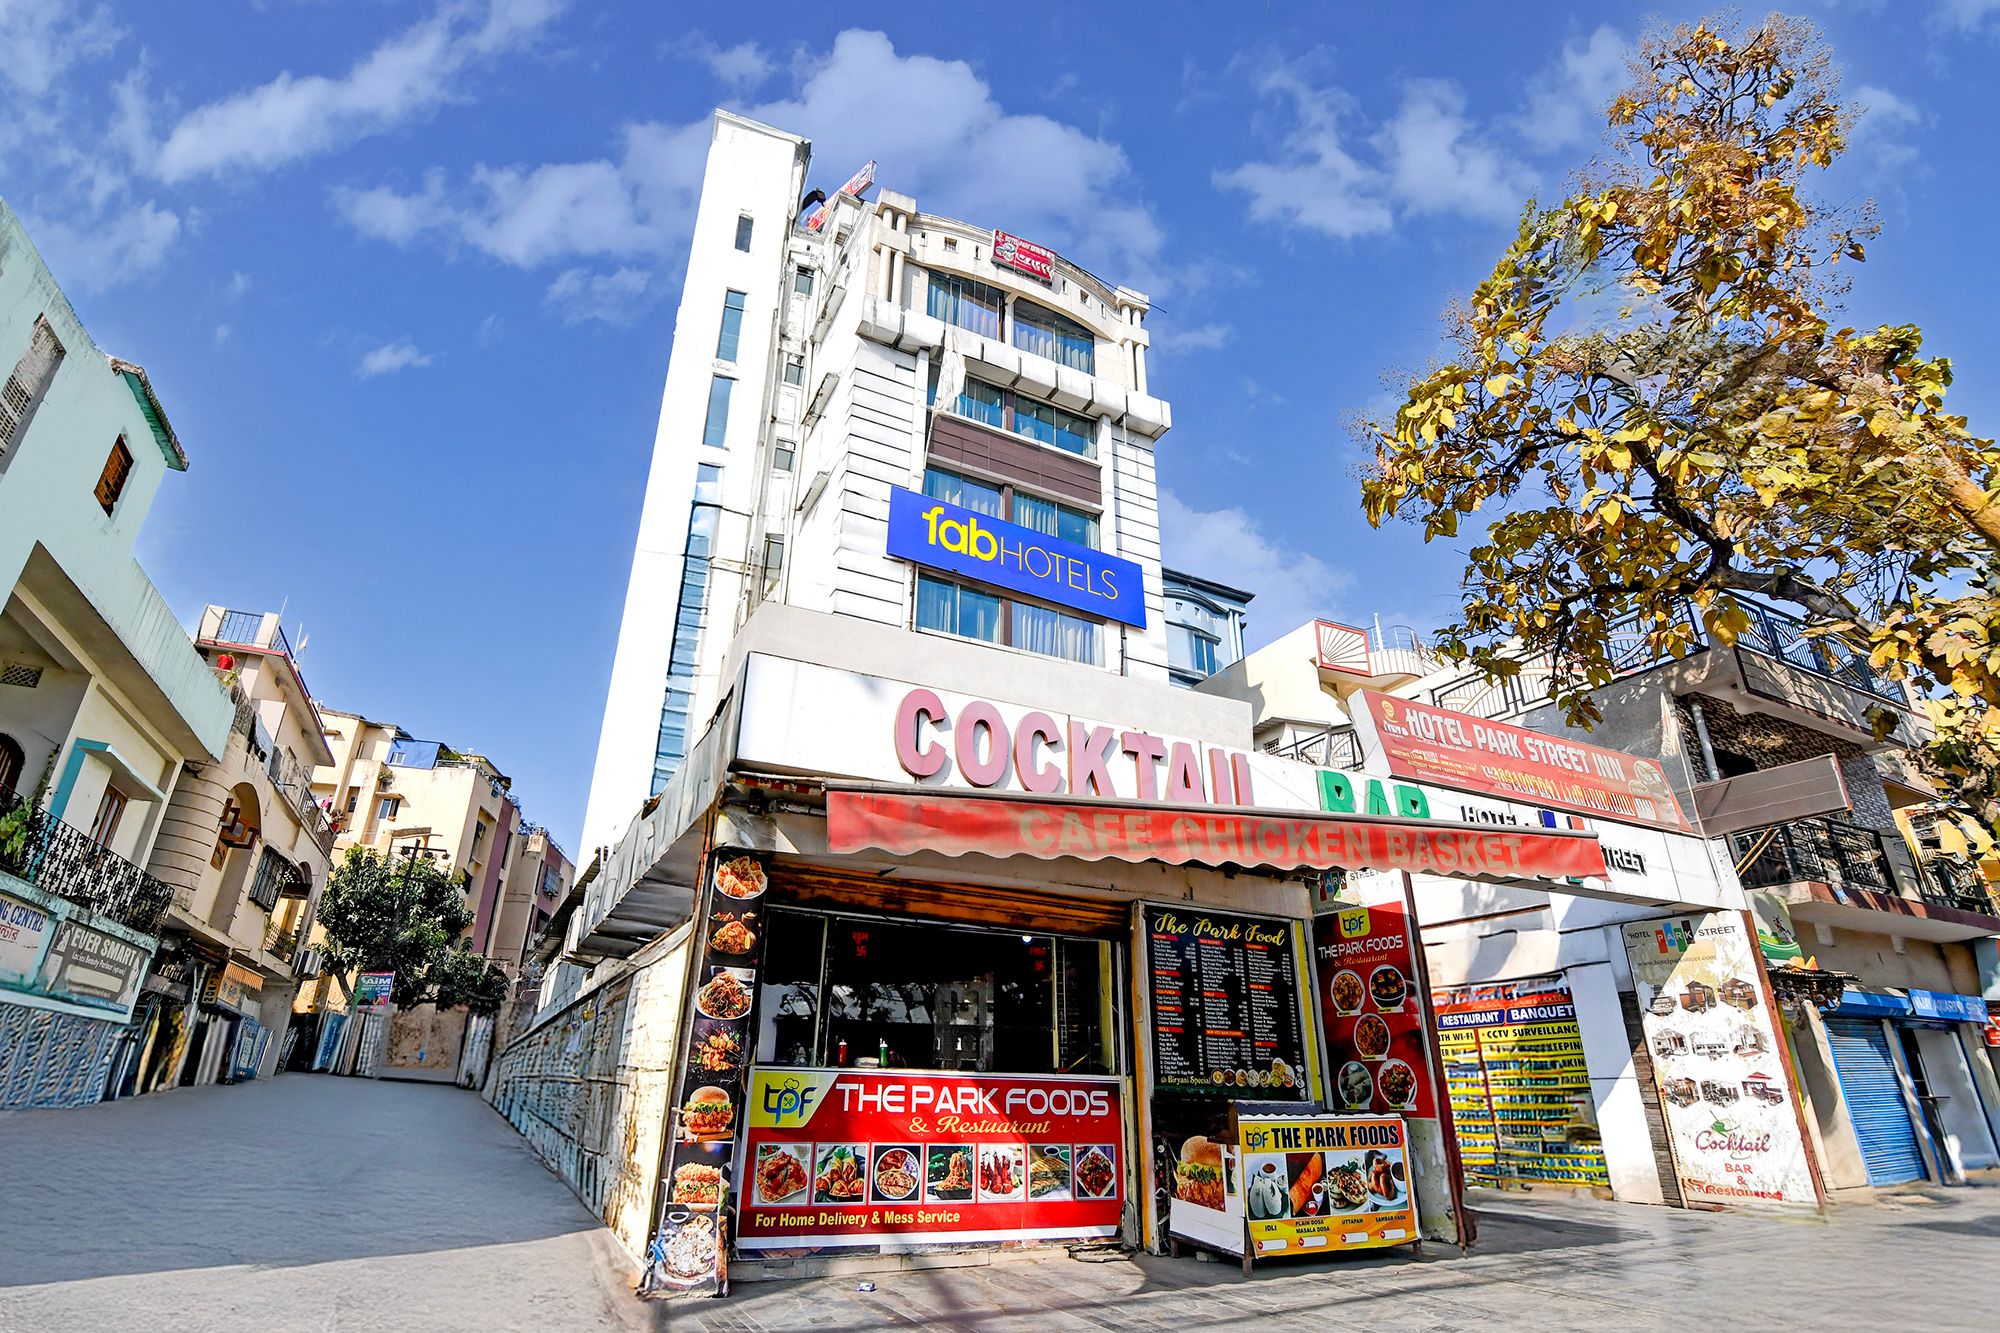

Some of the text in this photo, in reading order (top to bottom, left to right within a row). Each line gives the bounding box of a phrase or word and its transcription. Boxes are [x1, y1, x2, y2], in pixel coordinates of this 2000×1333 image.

[1405, 708, 1472, 748] HOTEL
[1473, 724, 1525, 760] PARK
[1524, 737, 1591, 775] STREET
[1591, 752, 1626, 782] INN
[1018, 809, 1522, 870] CAFE CHICKEN BASKET
[1600, 845, 1648, 877] TREET
[10, 905, 47, 932] CENTRE
[1153, 912, 1285, 946] The Park Food
[1698, 925, 1736, 937] STREET
[71, 927, 137, 966] EVER SMART
[1318, 935, 1404, 960] THE PARK FOODS
[1441, 1004, 1574, 1026] RESTAURANT BANQUET
[1453, 1031, 1474, 1042] WI-FI
[1487, 1024, 1579, 1039] CCTV SURVEILLANC
[835, 1083, 1110, 1117] THE PARK FOODS
[909, 1116, 930, 1133] &
[1271, 1124, 1399, 1149] THE PARK FOODS
[1695, 1130, 1771, 1153] Cocktail
[1724, 1162, 1752, 1174] BAR
[1736, 1175, 1746, 1186] &
[755, 1210, 960, 1227] For Home Delivery & Mess Service
